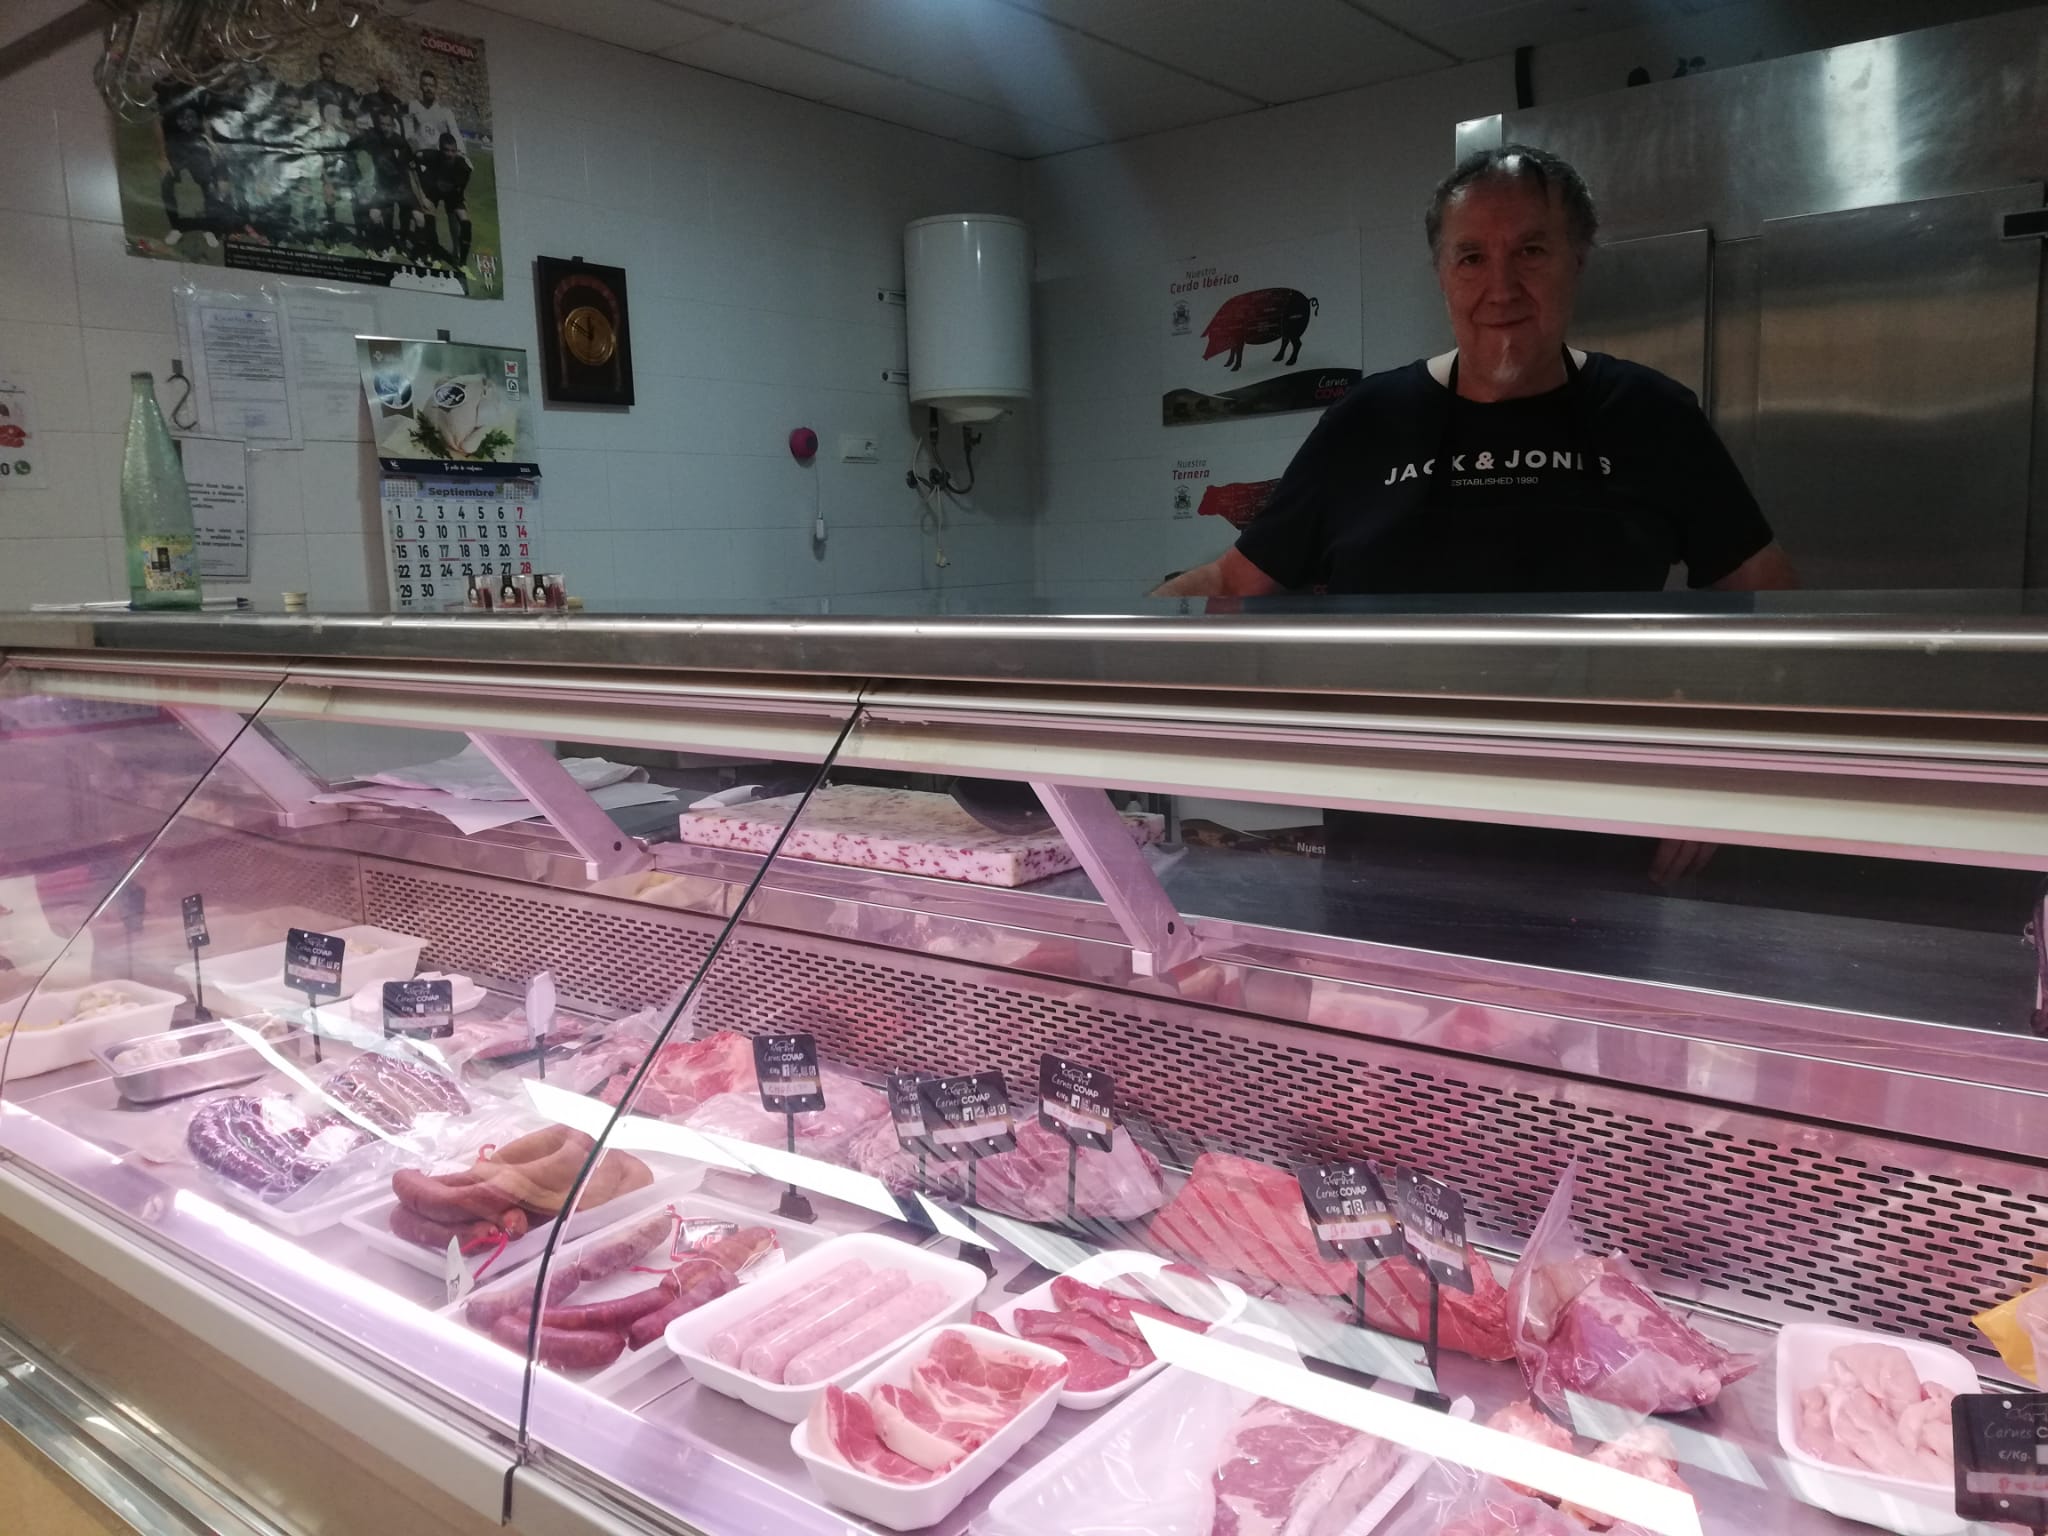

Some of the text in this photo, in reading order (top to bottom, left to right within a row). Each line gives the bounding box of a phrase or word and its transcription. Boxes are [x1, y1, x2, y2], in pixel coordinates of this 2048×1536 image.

[1170, 280, 1199, 294] Cerdo
[1474, 450, 1495, 471] &
[1172, 469, 1210, 480] Ternera
[1516, 476, 1539, 485] 1990
[428, 487, 494, 497] Septiembre
[396, 505, 523, 519] 1 2 3 4 5 6 7
[396, 525, 527, 538] 8 9 10 11 12 13 14
[396, 544, 528, 558] 15 16 17 18 19 20 21
[398, 562, 532, 578] 22 23 24 25 26 27 28
[400, 584, 434, 598] 29 30
[781, 1053, 804, 1062] COVAP
[1073, 1084, 1099, 1098] COVAP
[961, 1092, 990, 1105] COVAP
[1315, 1185, 1367, 1200] Carnes COVAP
[1425, 1203, 1449, 1222] COVAP
[1984, 1421, 2032, 1440] Carnes
[1998, 1449, 2032, 1463] €/Kg.
